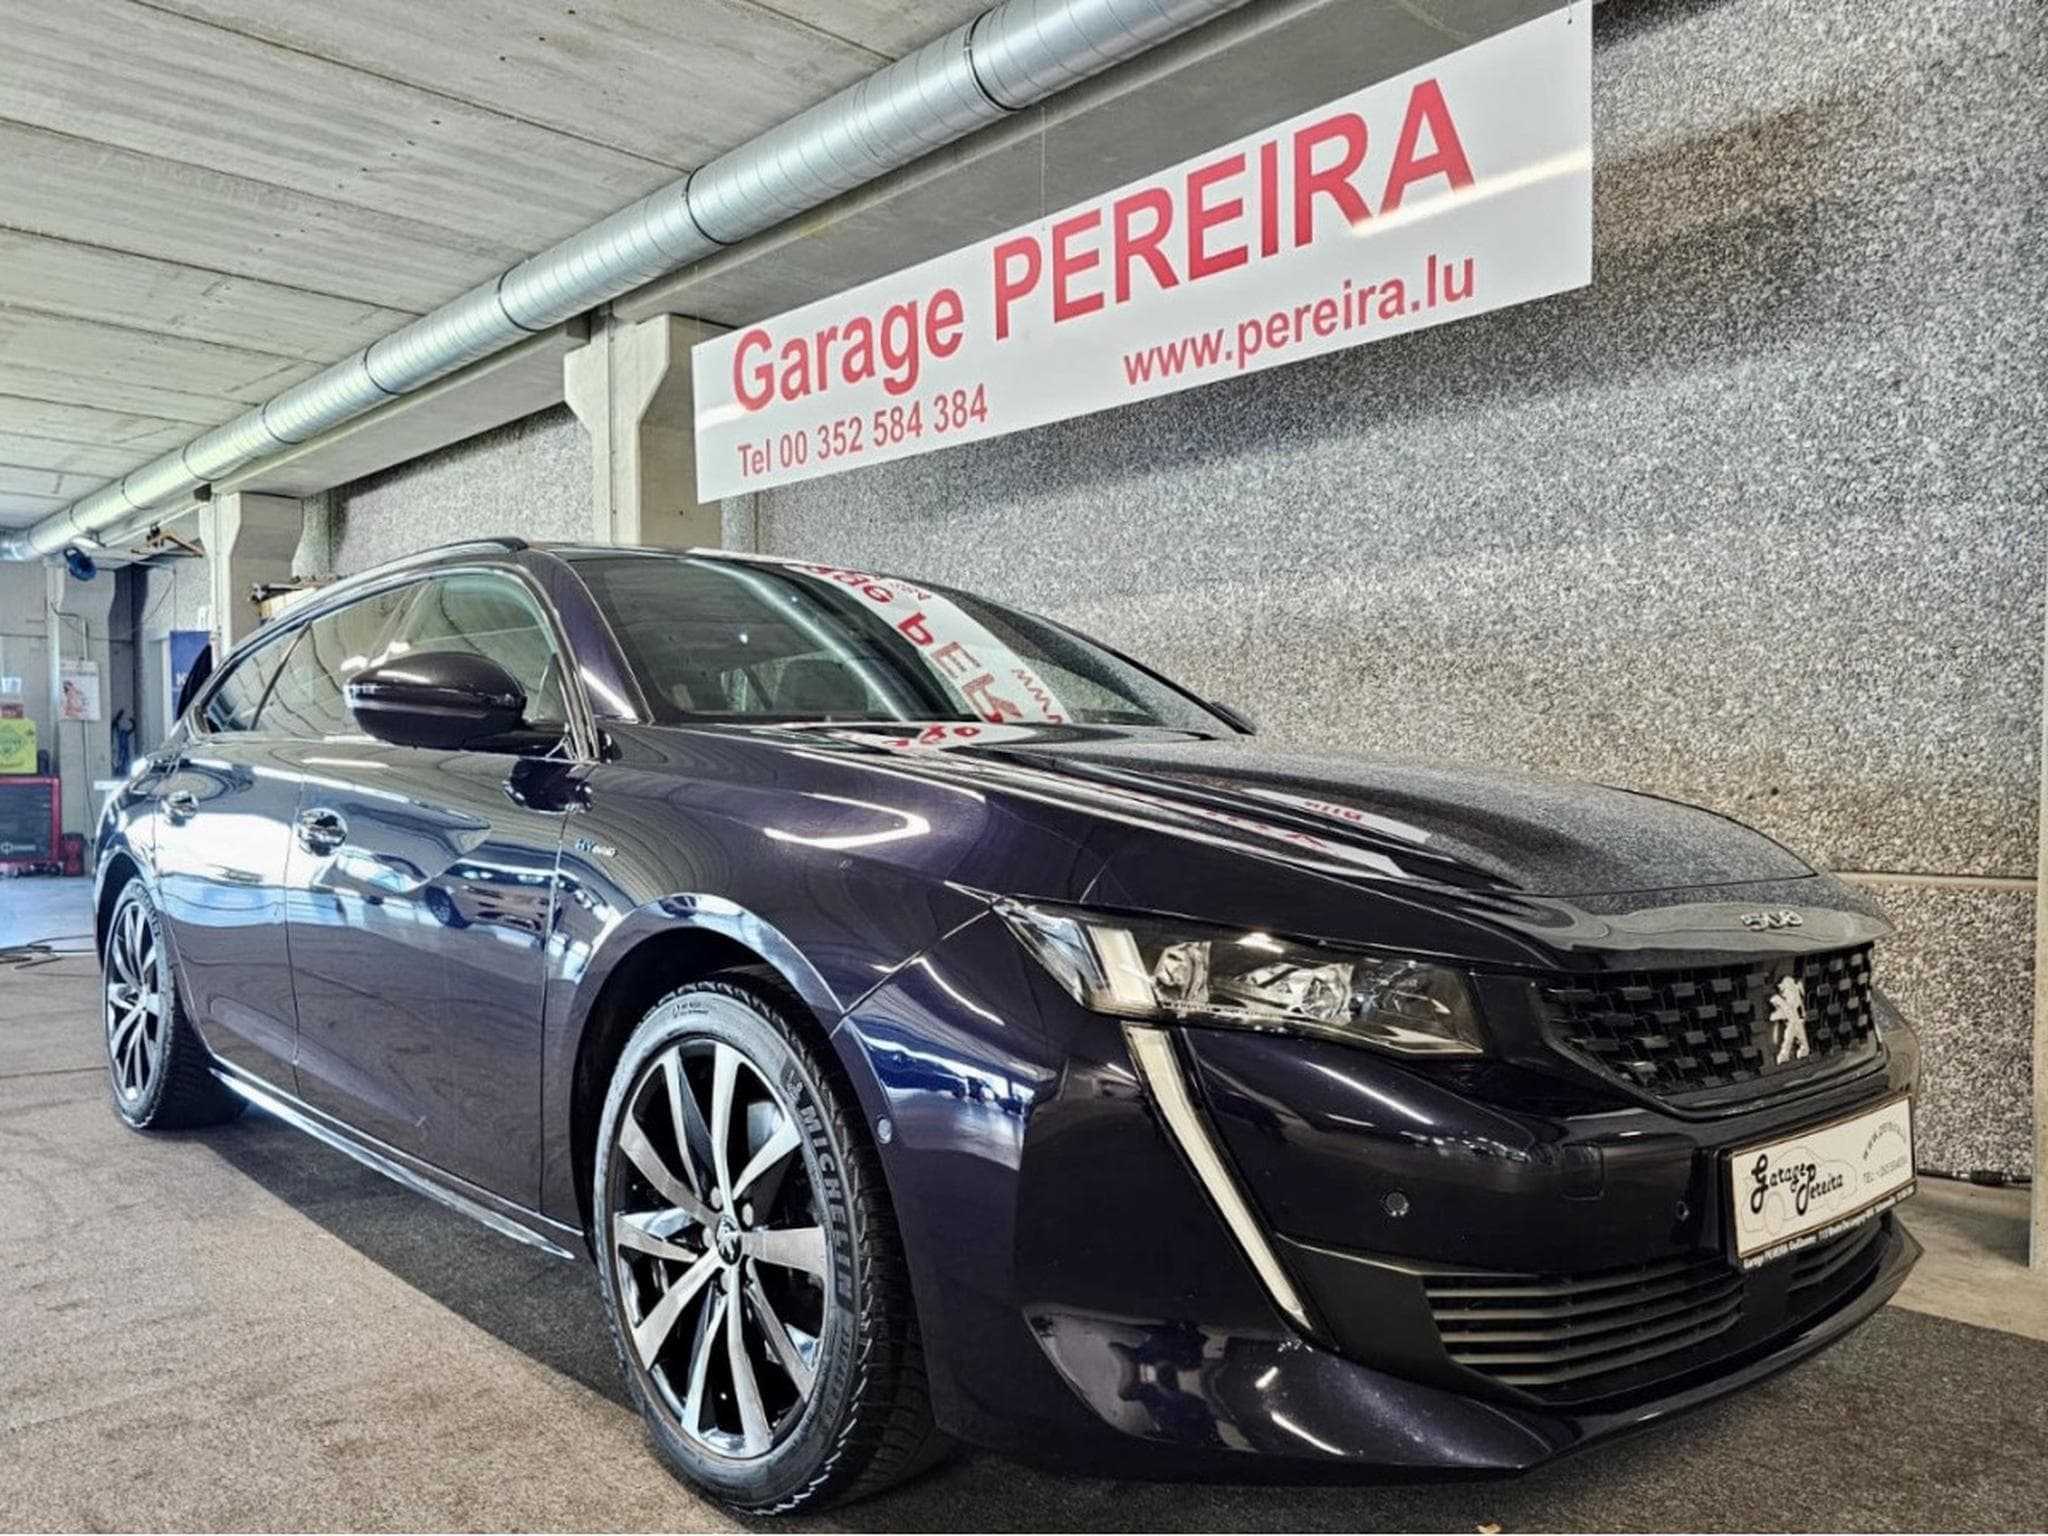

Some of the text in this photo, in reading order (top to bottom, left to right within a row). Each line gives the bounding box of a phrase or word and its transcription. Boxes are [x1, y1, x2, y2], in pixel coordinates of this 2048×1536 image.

[733, 78, 1475, 412] Garage PEREIRA
[1124, 255, 1476, 385] www.pereira.lu
[738, 383, 988, 477] Tel 00 352 584 384
[800, 1102, 854, 1300] MICHELIN
[1751, 1153, 1806, 1214] Garage
[1796, 1163, 1843, 1216] Pereira
